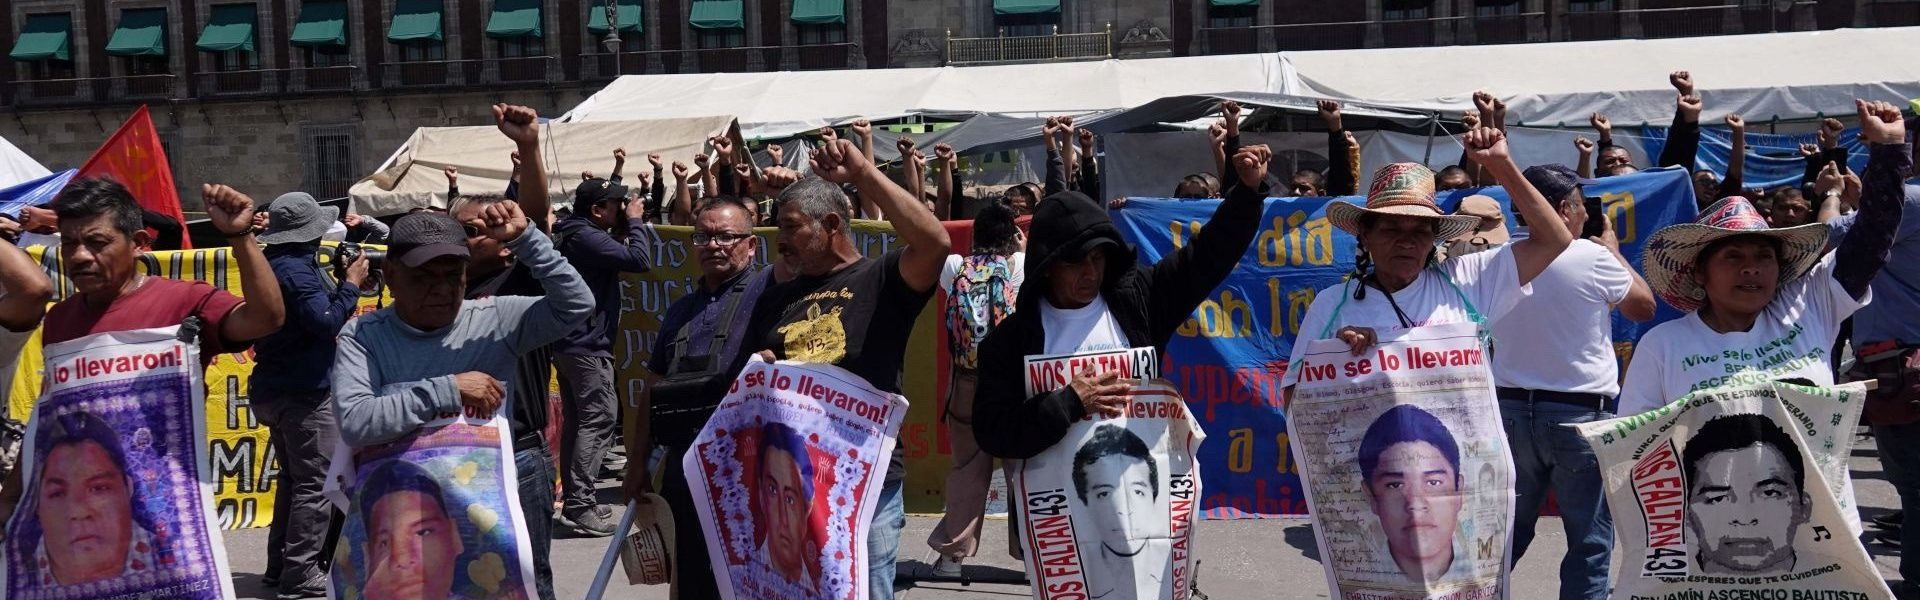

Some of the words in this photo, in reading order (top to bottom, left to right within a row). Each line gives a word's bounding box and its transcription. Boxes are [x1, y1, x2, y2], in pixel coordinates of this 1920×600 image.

[1257, 208, 1334, 267] día
[76, 345, 183, 380] llevaron!
[1029, 360, 1067, 395] NOS
[1344, 360, 1373, 378] se
[1378, 349, 1401, 372] lo
[744, 370, 765, 388] se
[769, 368, 791, 391] lo
[796, 374, 890, 425] llevaron!
[1631, 433, 1660, 460] NUNCA
[1692, 394, 1714, 409] QUE
[1716, 391, 1730, 402] TE
[1732, 388, 1777, 401] ESTAMOS
[1028, 488, 1068, 517] 43!
[1170, 472, 1194, 500] 43!
[1638, 476, 1683, 548] FALTAN
[1033, 514, 1081, 579] FALTAN
[1171, 500, 1192, 564] FALTAN
[1642, 547, 1688, 577] 43!
[1687, 575, 1737, 585] ESPERES
[1738, 576, 1761, 585] QUE
[1763, 576, 1779, 584] TE
[1780, 563, 1842, 582] OLVIDEMOS
[1708, 588, 1788, 600] ASCENCIO
[1791, 589, 1870, 600] BAUTISTA
